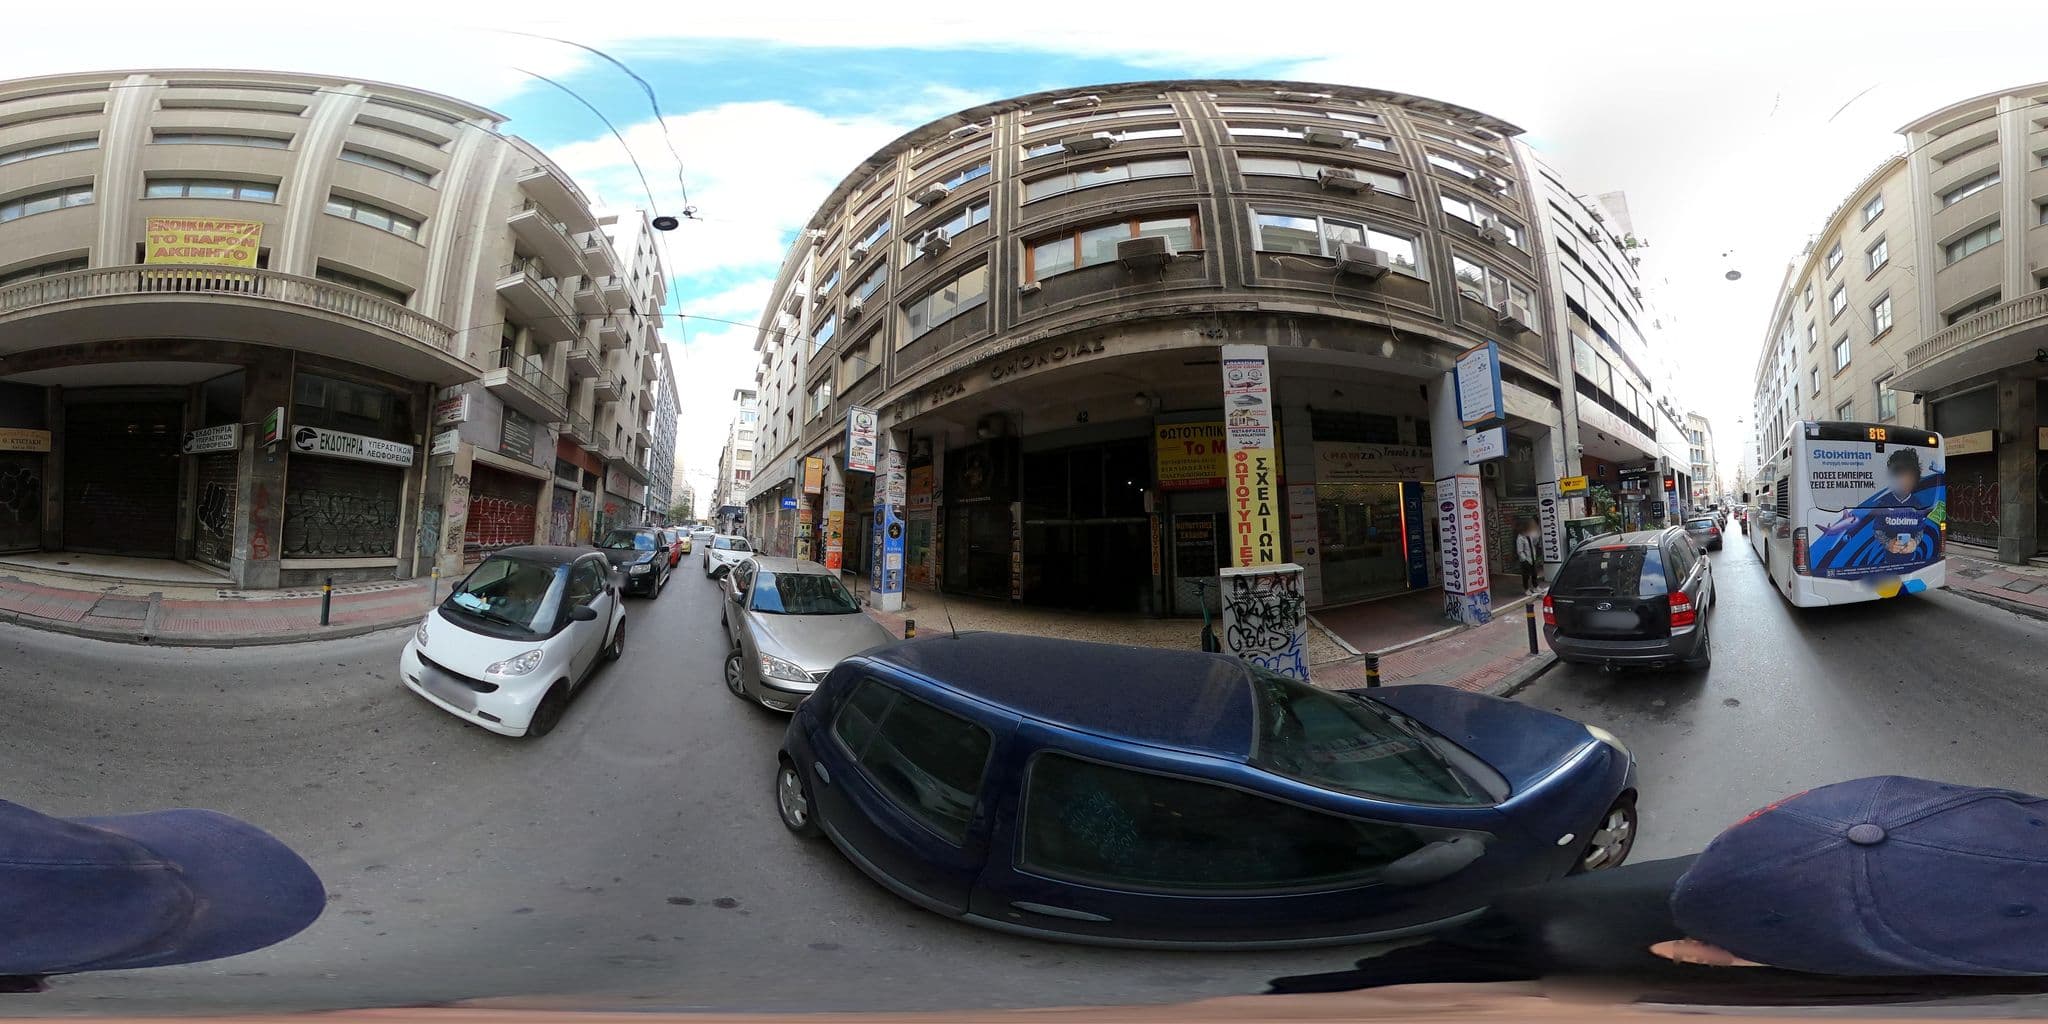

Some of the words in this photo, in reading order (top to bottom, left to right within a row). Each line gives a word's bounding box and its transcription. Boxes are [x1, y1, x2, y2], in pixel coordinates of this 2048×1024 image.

[150, 235, 177, 244] ΤΟ
[184, 234, 255, 247] ΠΑΡΟΝ
[154, 247, 248, 260] ΑΚΙΝΗΤΟ
[990, 336, 1105, 380] ΟΜΟΝΟΙΑΣ
[1160, 425, 1226, 439] ΦΩΤΟΤΥΠΙΚ
[1868, 427, 1886, 440] 813
[320, 433, 363, 455] ΕΚΔΟΤΗΡΙΑ
[368, 440, 412, 455] ΥΠΕΡΑΣΤΙΚΩΝ
[366, 449, 411, 463] ΛΕΩΦΟΡΕΙΩΝ
[1813, 448, 1872, 460] Stoiximan
[1812, 471, 1836, 480] ΠΟΣΕΣ
[1837, 471, 1873, 480] ΕΜΠΕΙΡΙΕΣ
[1826, 480, 1835, 489] ΣΕ
[1836, 480, 1849, 489] ΜΙΑ
[1256, 458, 1273, 562] ΣΧΕΔΙΩΝ
